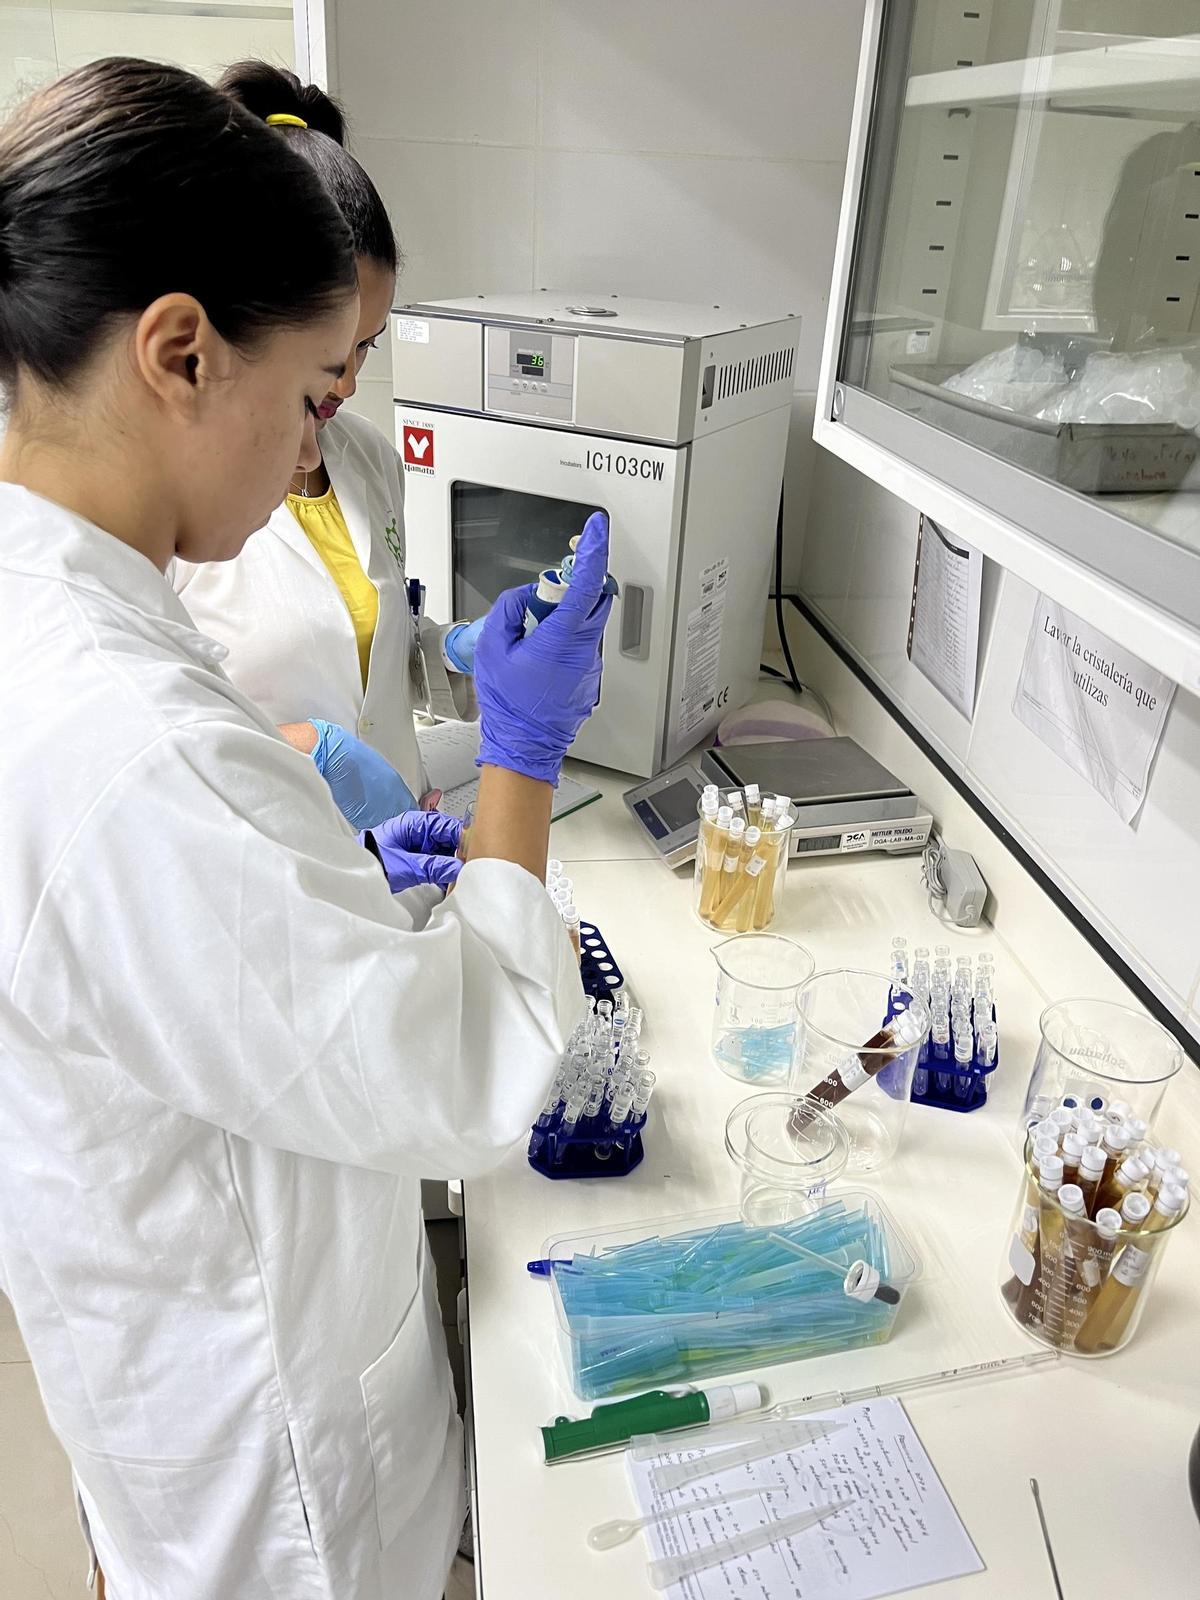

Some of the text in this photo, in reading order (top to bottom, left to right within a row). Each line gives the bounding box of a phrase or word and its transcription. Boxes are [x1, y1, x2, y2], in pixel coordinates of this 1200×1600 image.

[532, 354, 544, 366] 36
[586, 450, 665, 481] IC103CW
[1044, 616, 1157, 711] Lavar la cristalería que
[1073, 670, 1109, 708] utilizas
